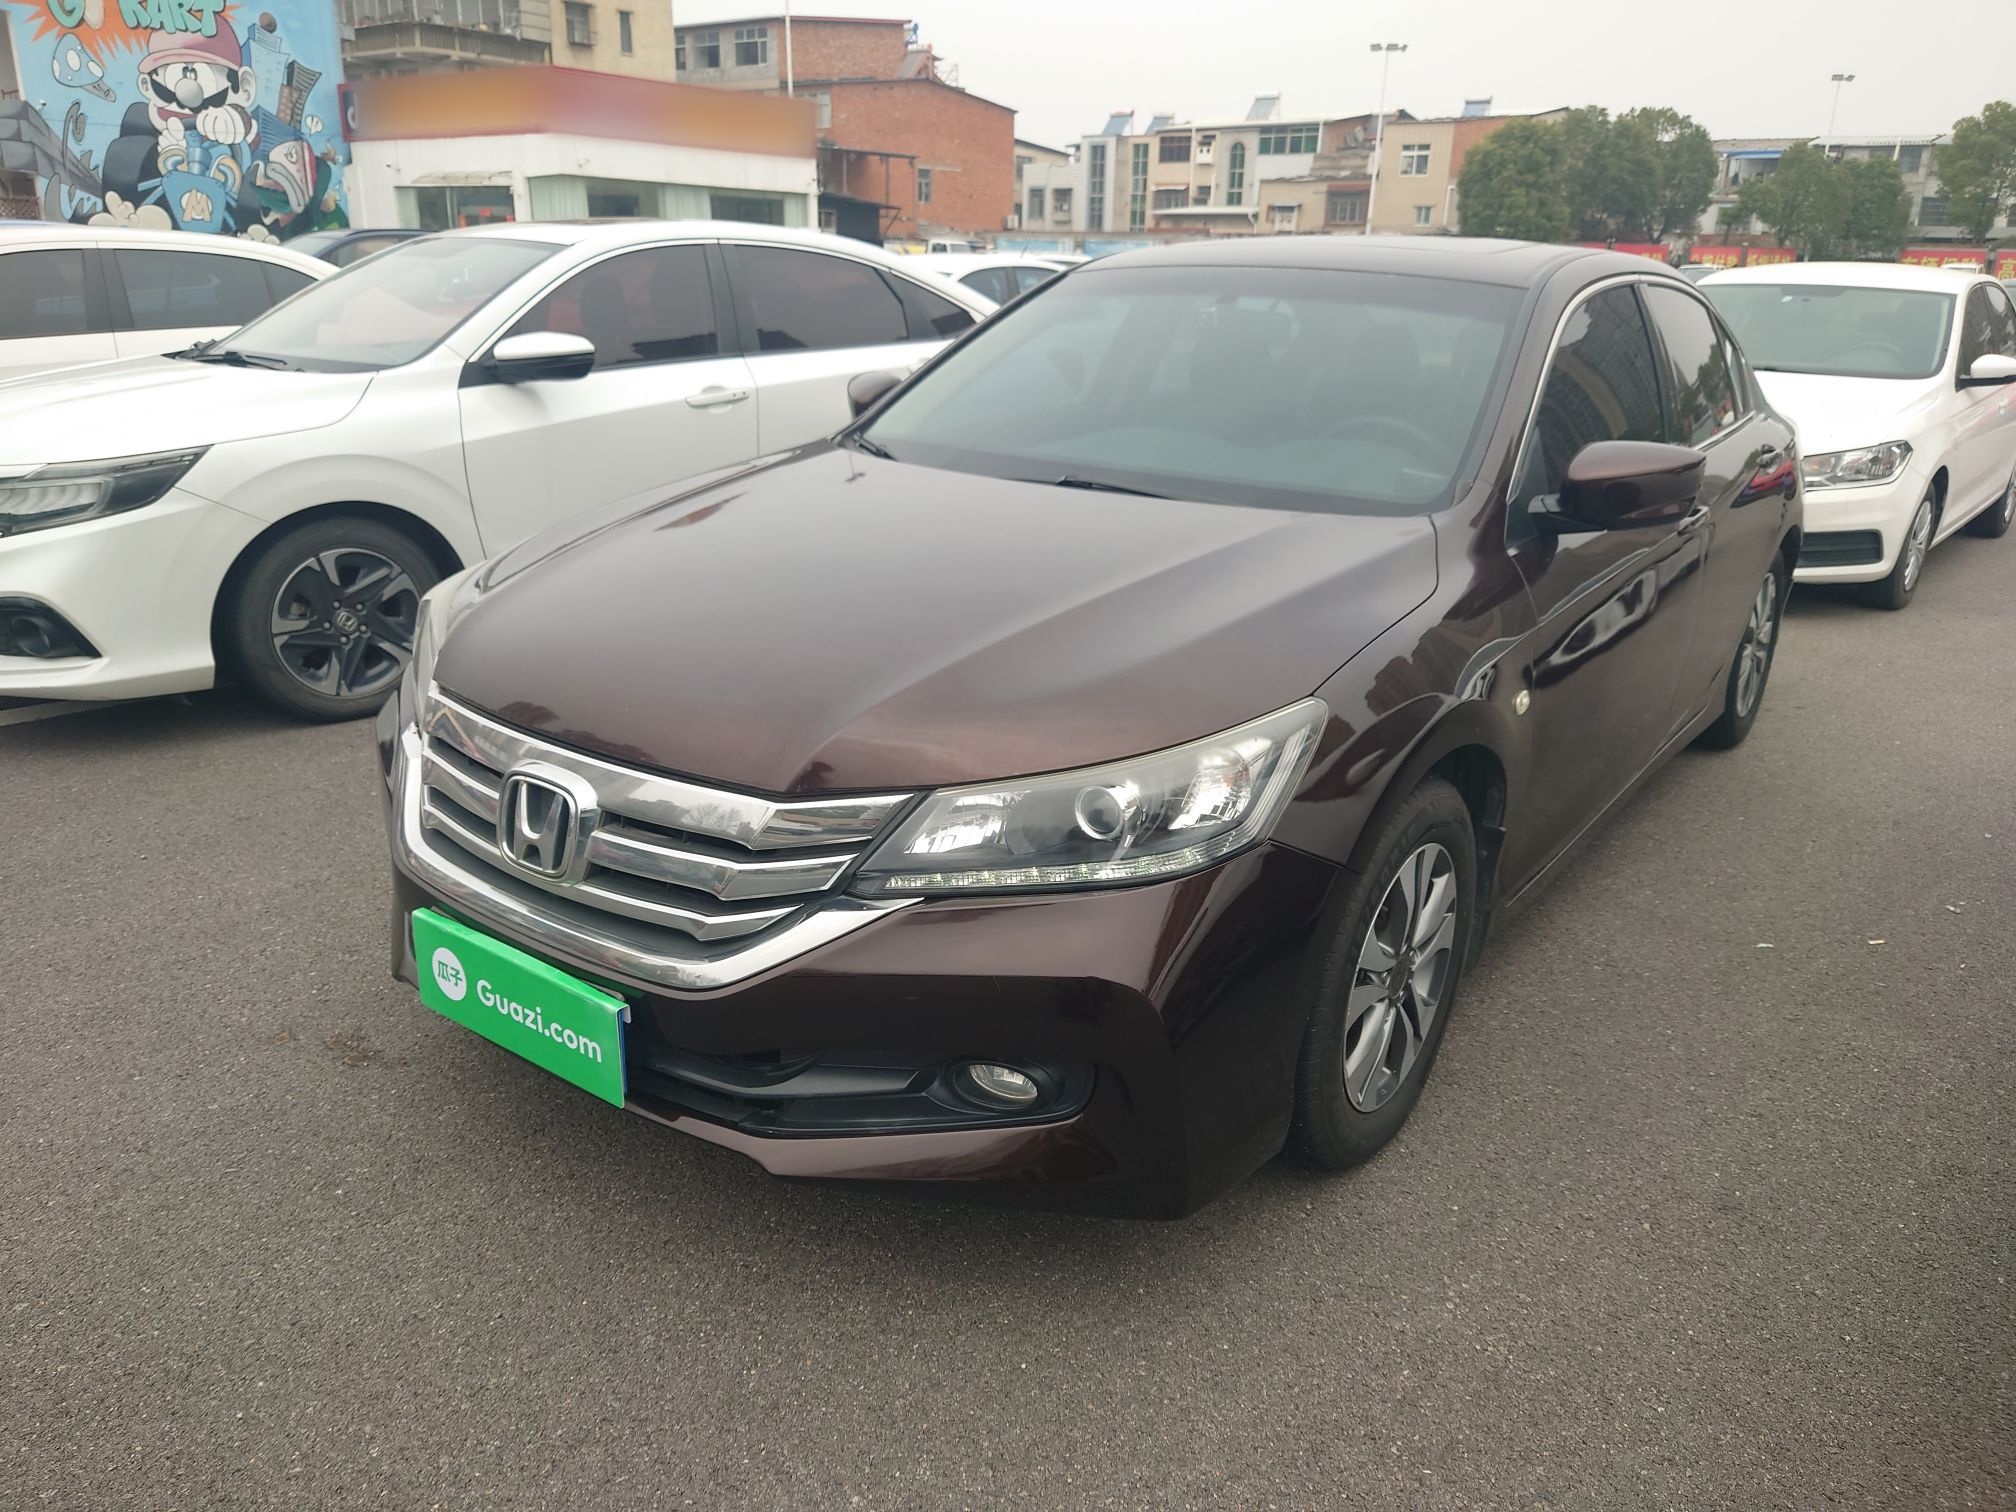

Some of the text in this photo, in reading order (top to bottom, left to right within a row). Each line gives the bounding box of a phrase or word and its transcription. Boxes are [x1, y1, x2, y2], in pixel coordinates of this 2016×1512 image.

[118, 0, 226, 38] KART
[437, 960, 463, 987] 瓜子
[476, 979, 602, 1063] Guazi.com
